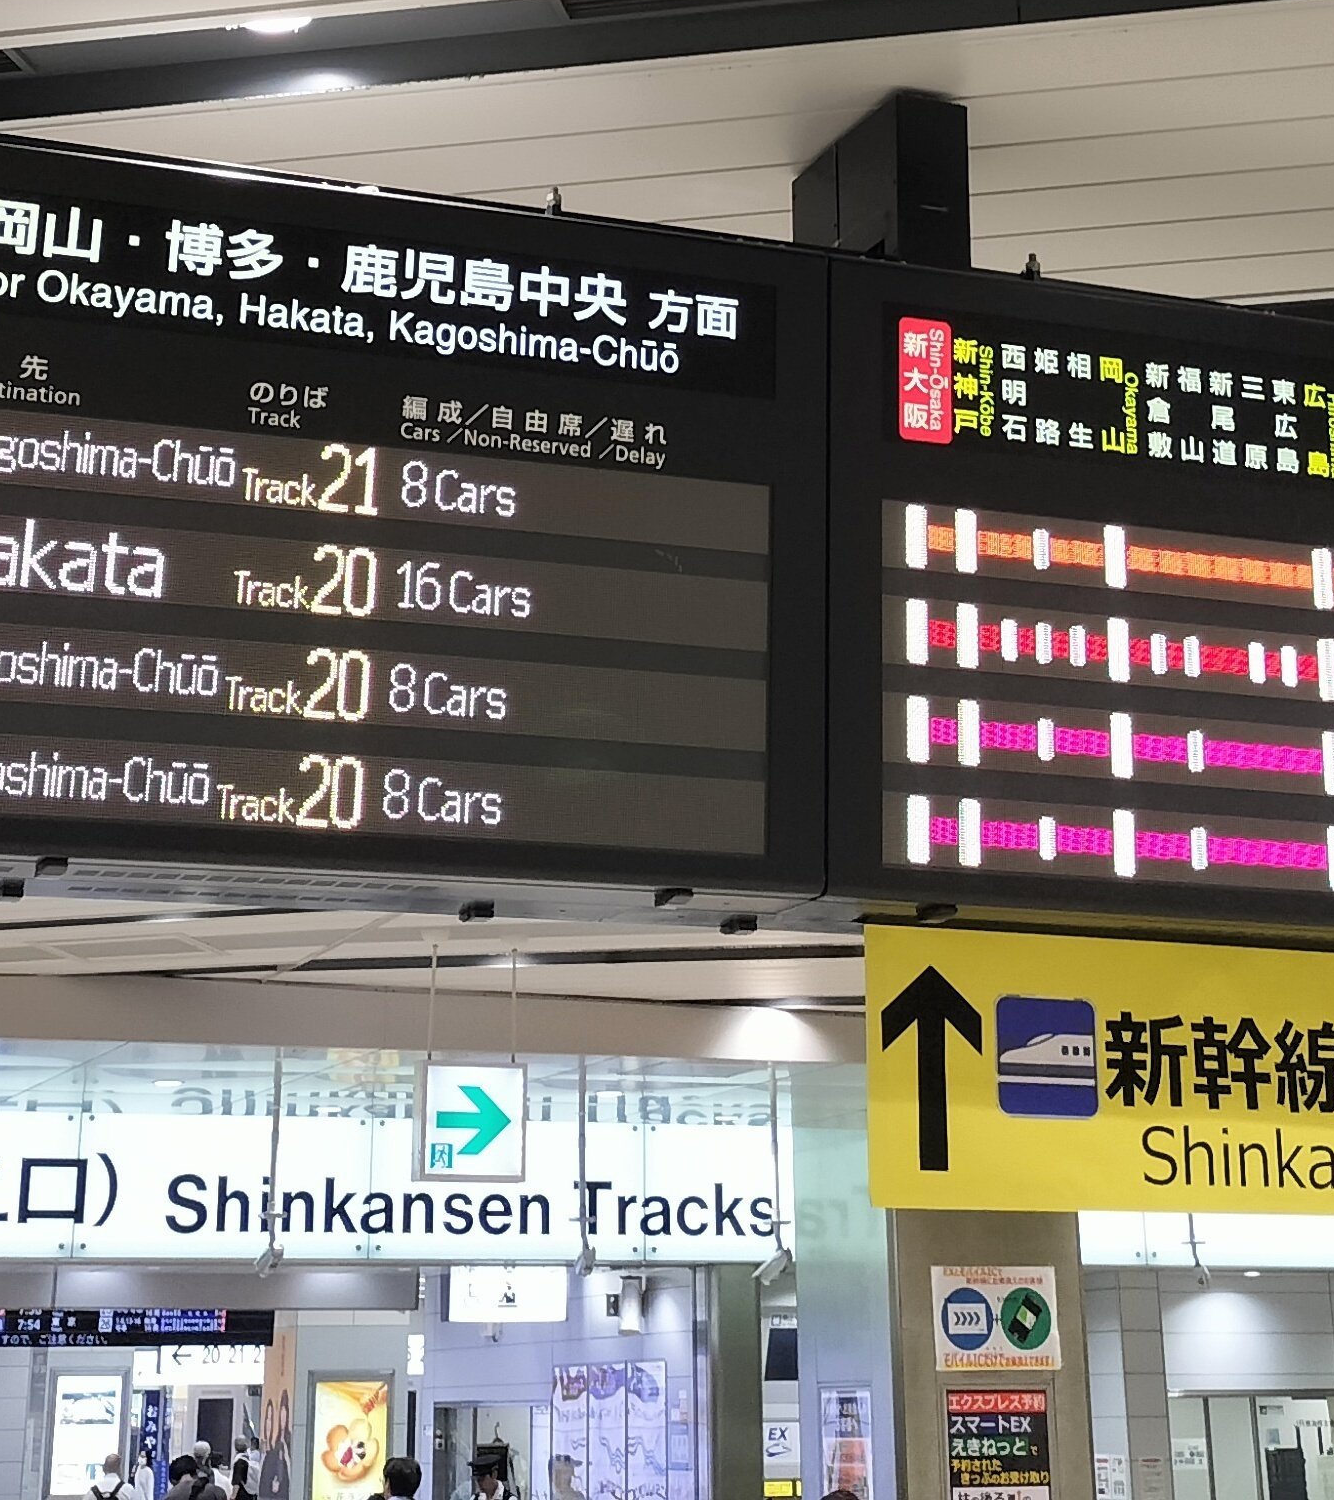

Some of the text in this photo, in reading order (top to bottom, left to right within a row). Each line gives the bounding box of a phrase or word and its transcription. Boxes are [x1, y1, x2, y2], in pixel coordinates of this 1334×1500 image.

[37, 269, 225, 327] Okayama,
[239, 294, 375, 343] Hakata,
[388, 311, 680, 376] Kagoshima-Chūō
[648, 288, 740, 341] 方面
[250, 381, 328, 411] のりば
[902, 332, 930, 429] 新大阪
[929, 328, 949, 431] Shin-Ōsaka
[953, 338, 979, 434] 新神戸
[979, 345, 995, 437] Shin-Kōbe
[1001, 343, 1027, 442] 西明石
[1034, 348, 1061, 446] 姫路
[1067, 353, 1094, 450] 相生
[1099, 356, 1125, 454] 岡山
[1124, 371, 1139, 455] Okayama
[1146, 362, 1173, 460] 新倉敷
[1177, 366, 1205, 463] 福山
[247, 406, 301, 430] Track
[400, 421, 441, 444] Cars
[1209, 370, 1237, 467] 新尾道
[1241, 375, 1267, 470] 三原
[1272, 378, 1300, 475] 東広島
[1303, 383, 1330, 477] 広島
[243, 442, 378, 517] Track 21
[433, 468, 517, 519] Cars
[234, 544, 376, 617] Track 20
[448, 567, 532, 619] Cars
[226, 648, 370, 723] Track 20
[423, 671, 508, 722] Cars
[217, 755, 362, 831] Track 20
[418, 778, 503, 829] Cars
[166, 1172, 777, 1239] Shinkansen Tracks
[17, 1319, 41, 1331] 7:54
[203, 1346, 221, 1364] 20
[768, 1427, 788, 1442] EX
[950, 1415, 1031, 1434] スマートEX
